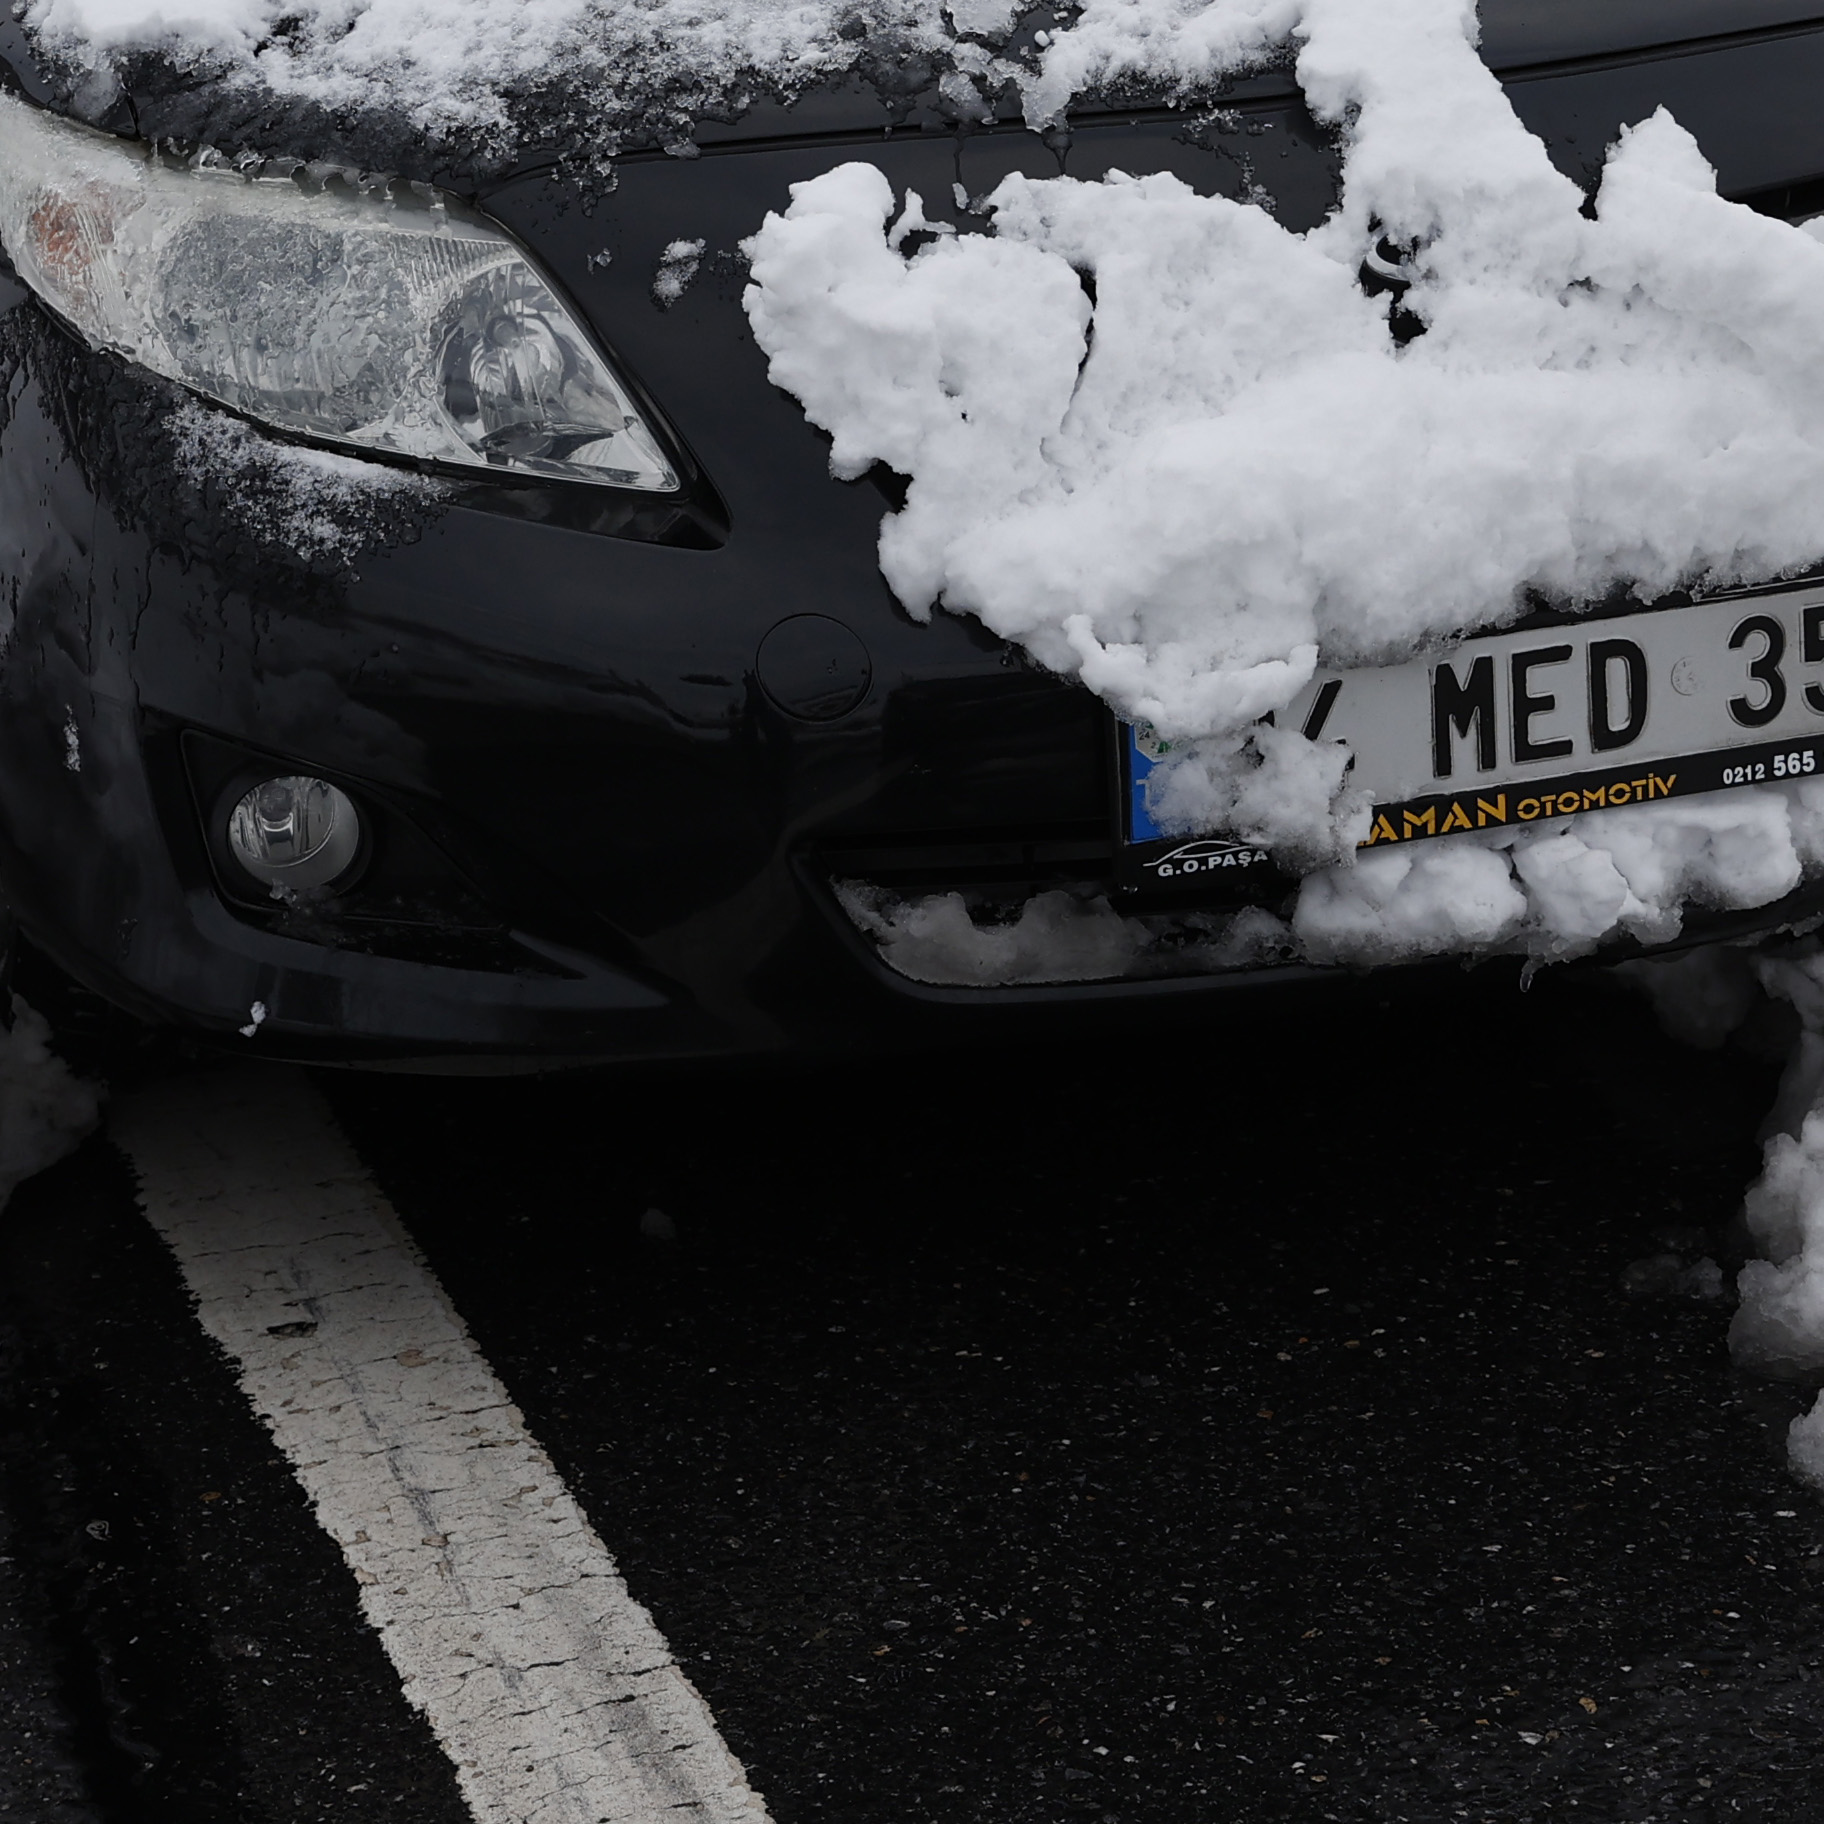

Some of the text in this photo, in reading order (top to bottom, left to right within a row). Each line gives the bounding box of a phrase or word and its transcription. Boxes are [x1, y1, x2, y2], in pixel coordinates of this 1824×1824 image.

[1430, 638, 1650, 778] MED
[1722, 763, 1765, 785] 0212
[1773, 750, 1815, 777] 565
[1357, 772, 1677, 847] AMAN OTOMOTİV
[1157, 849, 1269, 878] G.O.PAŞA
